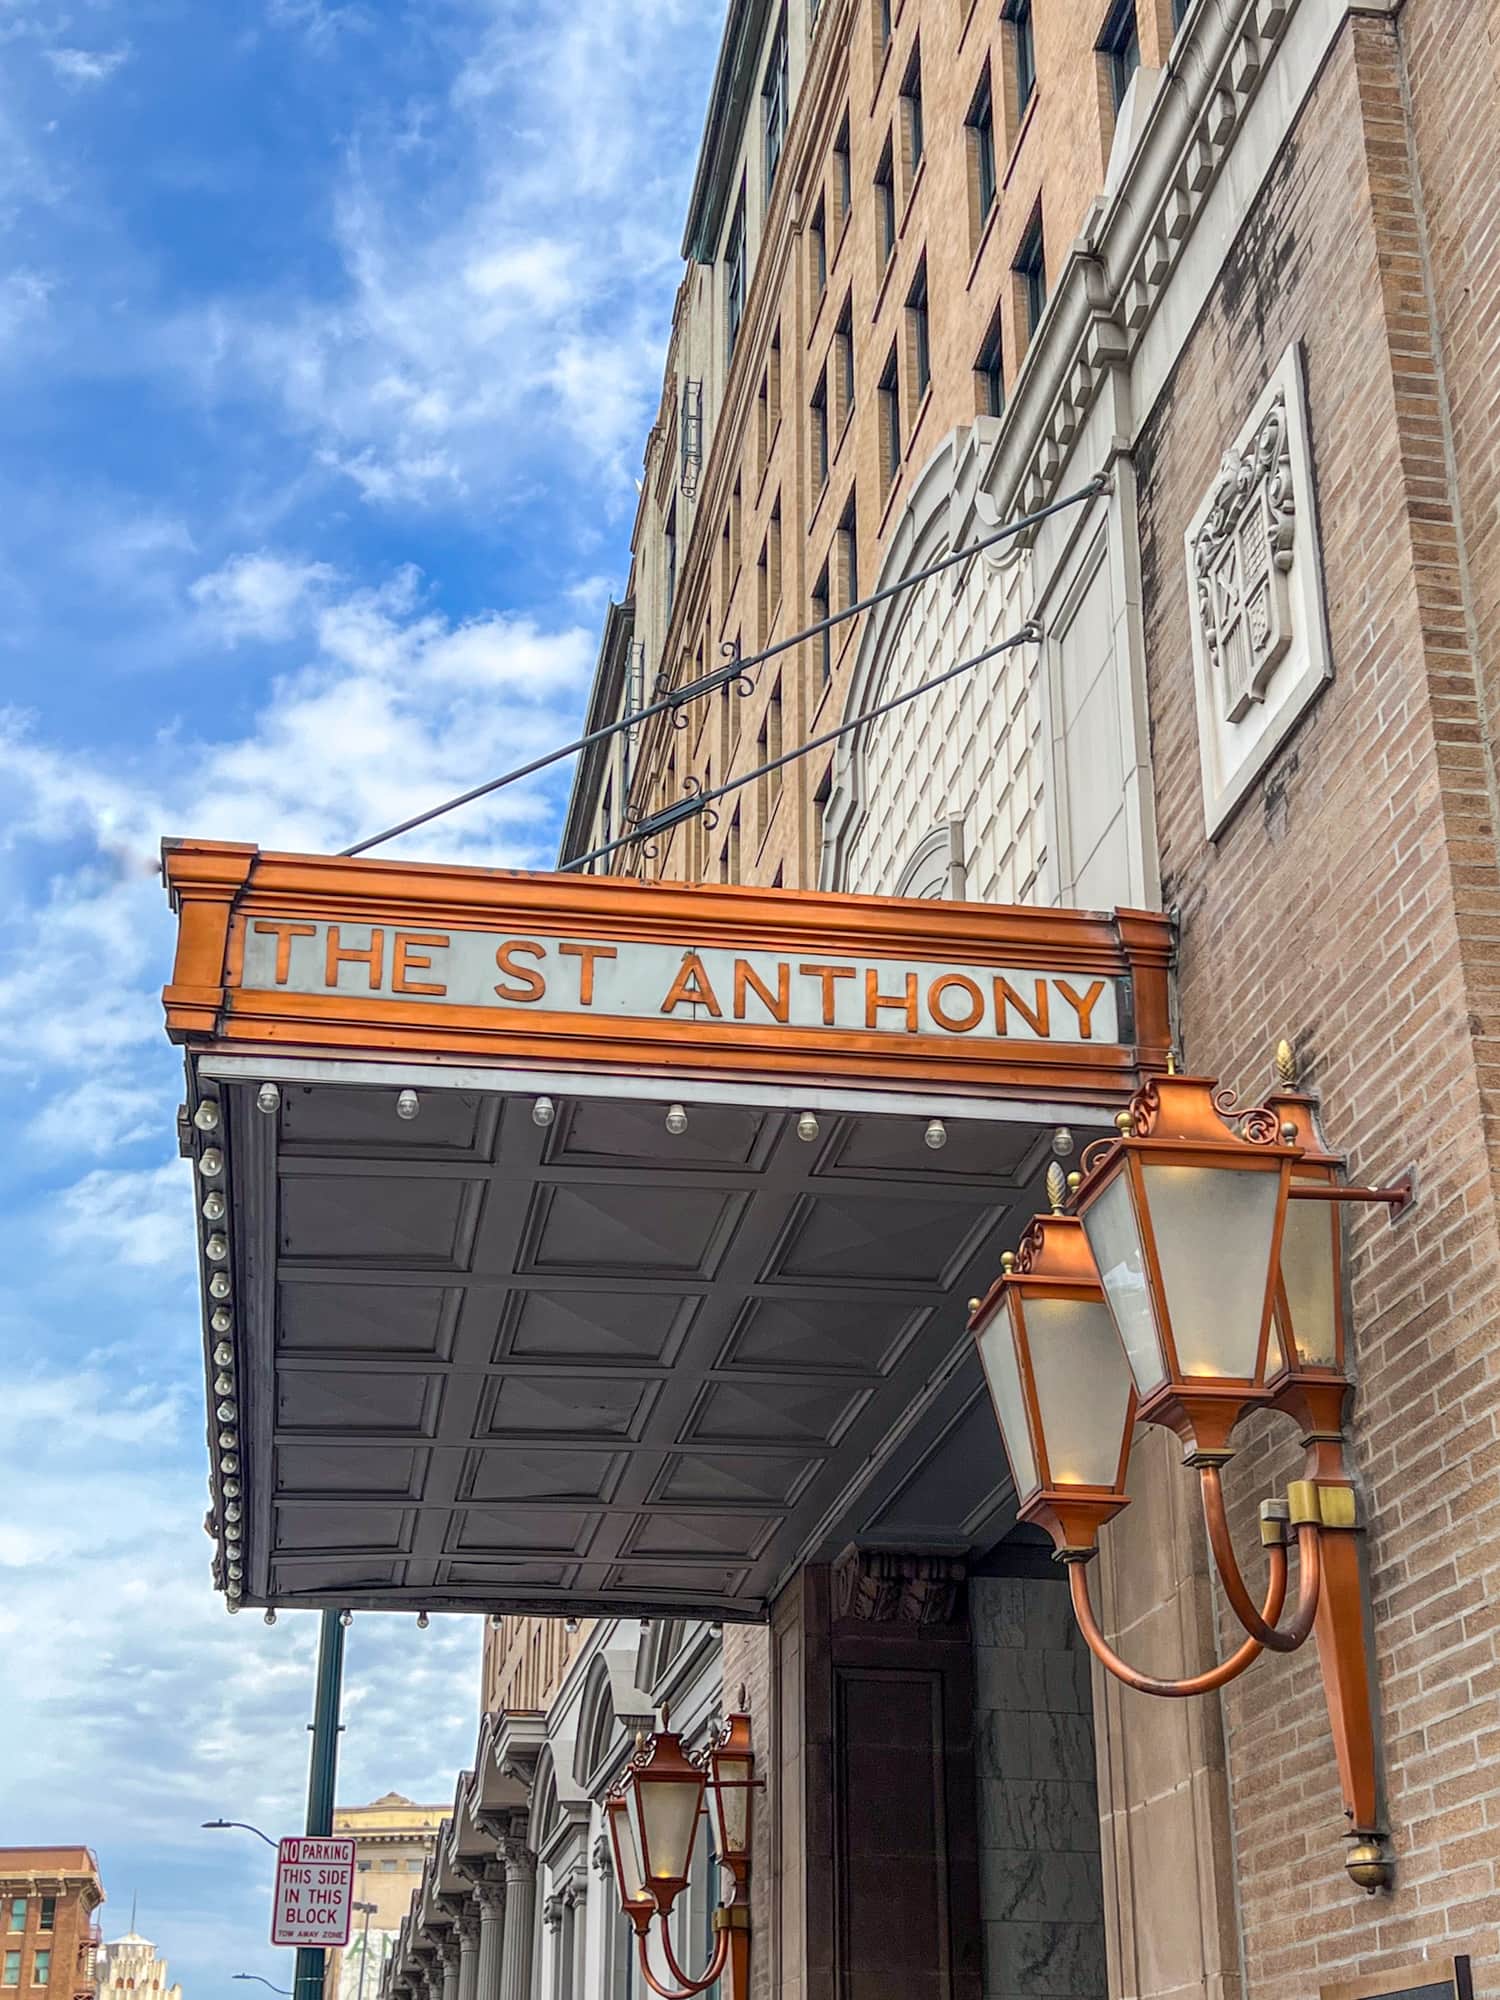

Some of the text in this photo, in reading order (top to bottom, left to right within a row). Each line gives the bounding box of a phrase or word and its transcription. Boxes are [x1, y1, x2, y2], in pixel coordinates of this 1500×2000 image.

[254, 921, 1105, 1040] THE ST ANTHONY
[281, 1841, 349, 1863] NO PARKING
[283, 1869, 348, 1885] THIS SIDE
[285, 1889, 342, 1904] IN THIS
[286, 1908, 337, 1924] BLOCK
[278, 1930, 293, 1938] TOW
